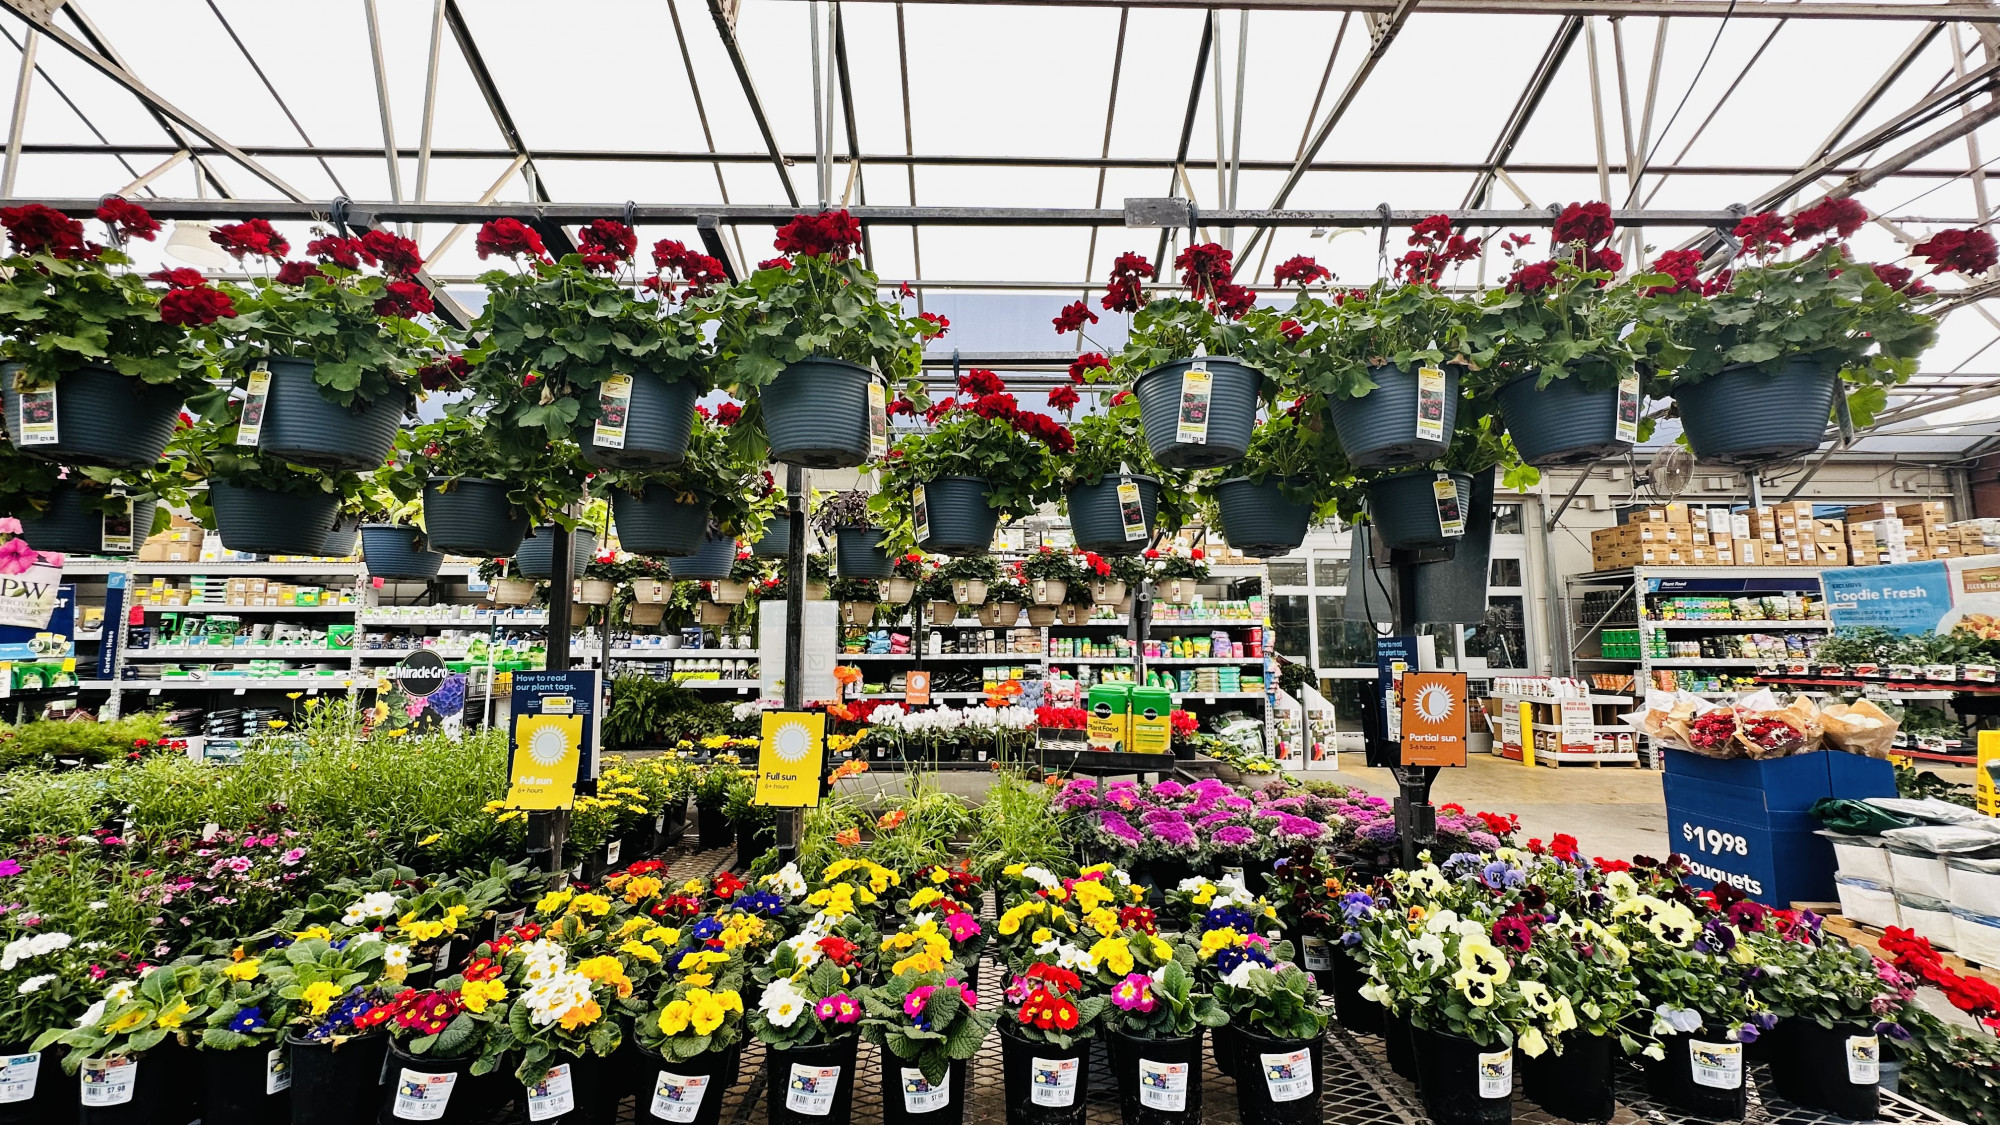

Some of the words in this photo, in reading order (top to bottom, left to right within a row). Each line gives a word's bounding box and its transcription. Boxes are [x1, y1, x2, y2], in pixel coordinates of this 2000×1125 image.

[1834, 589, 1880, 601] Foodie
[1883, 586, 1927, 599] Fresh
[105, 630, 115, 646] Hose
[103, 646, 112, 674] Garden
[516, 674, 536, 682] How
[536, 674, 546, 682] to
[547, 674, 567, 682] read
[531, 683, 554, 692] plant
[555, 684, 576, 692] tags.
[1409, 732, 1439, 742] Partial
[1441, 734, 1457, 742] sun
[519, 776, 534, 785] Full
[535, 777, 553, 785] sun
[765, 772, 780, 781] Full
[781, 774, 797, 782] sun
[1679, 853, 1763, 895] Bouquets
[107, 1085, 126, 1094] $7.98
